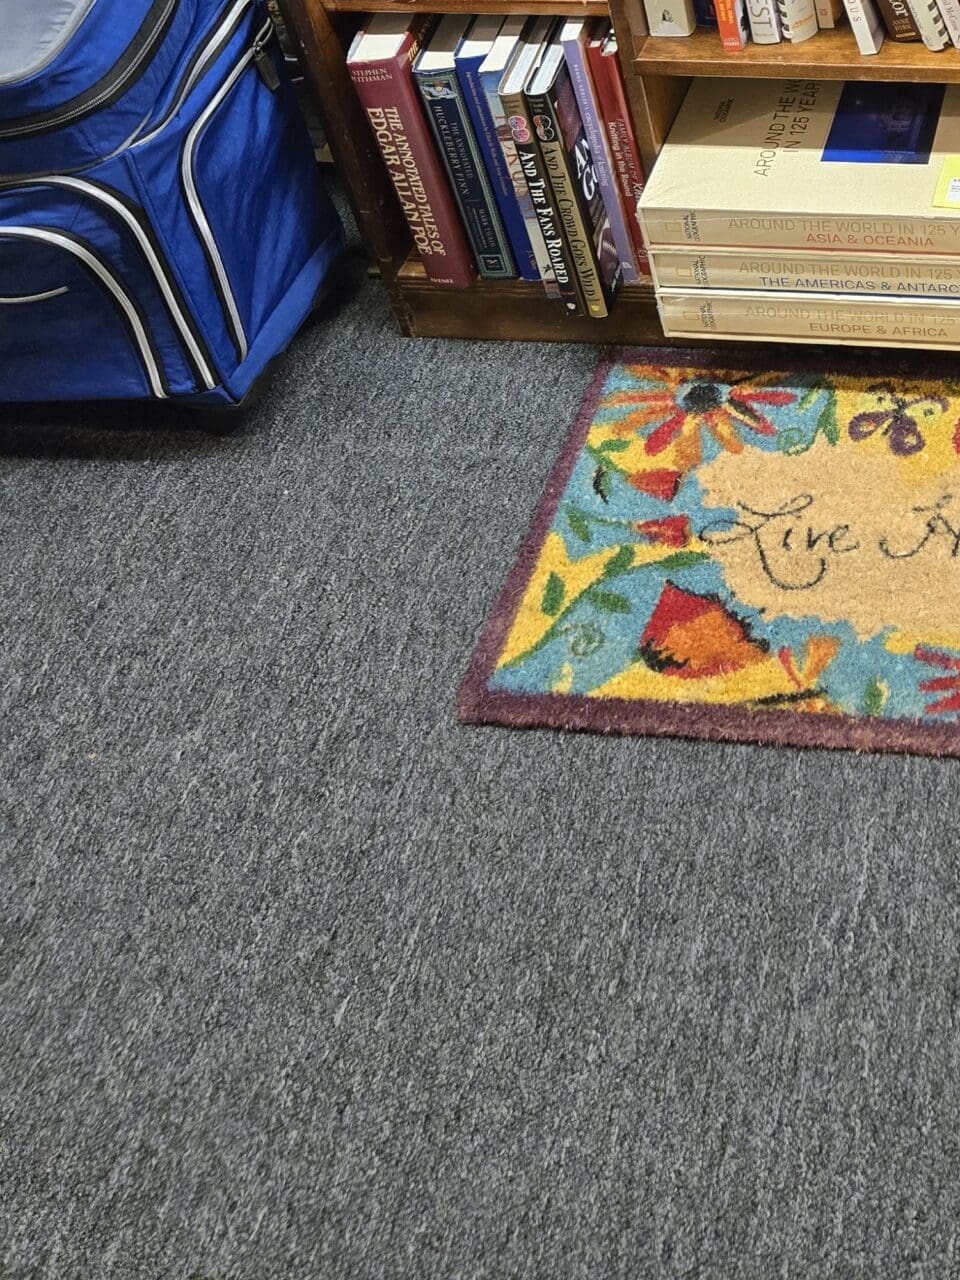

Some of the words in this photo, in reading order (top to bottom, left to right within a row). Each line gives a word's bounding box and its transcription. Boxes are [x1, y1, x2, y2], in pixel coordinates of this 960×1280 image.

[384, 106, 400, 130] THE
[754, 128, 782, 178] AROUND
[773, 96, 794, 124] THE
[391, 131, 427, 201] ANNOTATED
[519, 150, 536, 178] AND
[366, 106, 394, 171] EDGAR
[387, 170, 418, 221] ALLAN
[411, 222, 432, 256] POE
[526, 179, 546, 206] THE
[416, 202, 441, 238] TALES
[537, 207, 556, 237] FANS
[728, 218, 800, 232] AROUND
[804, 219, 834, 233] THE
[836, 220, 894, 234] WORLD
[898, 222, 914, 236] IN
[920, 223, 947, 236] 125
[432, 238, 447, 256] OF
[806, 233, 843, 244] ASIA
[848, 234, 860, 244] &
[864, 234, 935, 247] OCEANIA
[546, 237, 570, 285] ROARED
[738, 262, 806, 276] AROUND
[808, 264, 835, 277] THE
[838, 265, 900, 279] WORLD
[904, 267, 920, 280] IN
[928, 268, 951, 280] 125
[760, 276, 791, 288] THE
[794, 278, 878, 292] AMERICAS
[881, 281, 894, 292] &
[810, 323, 872, 335] EUROPE
[876, 324, 888, 336] &
[892, 325, 948, 338] AFRICA
[697, 492, 862, 594] Live
